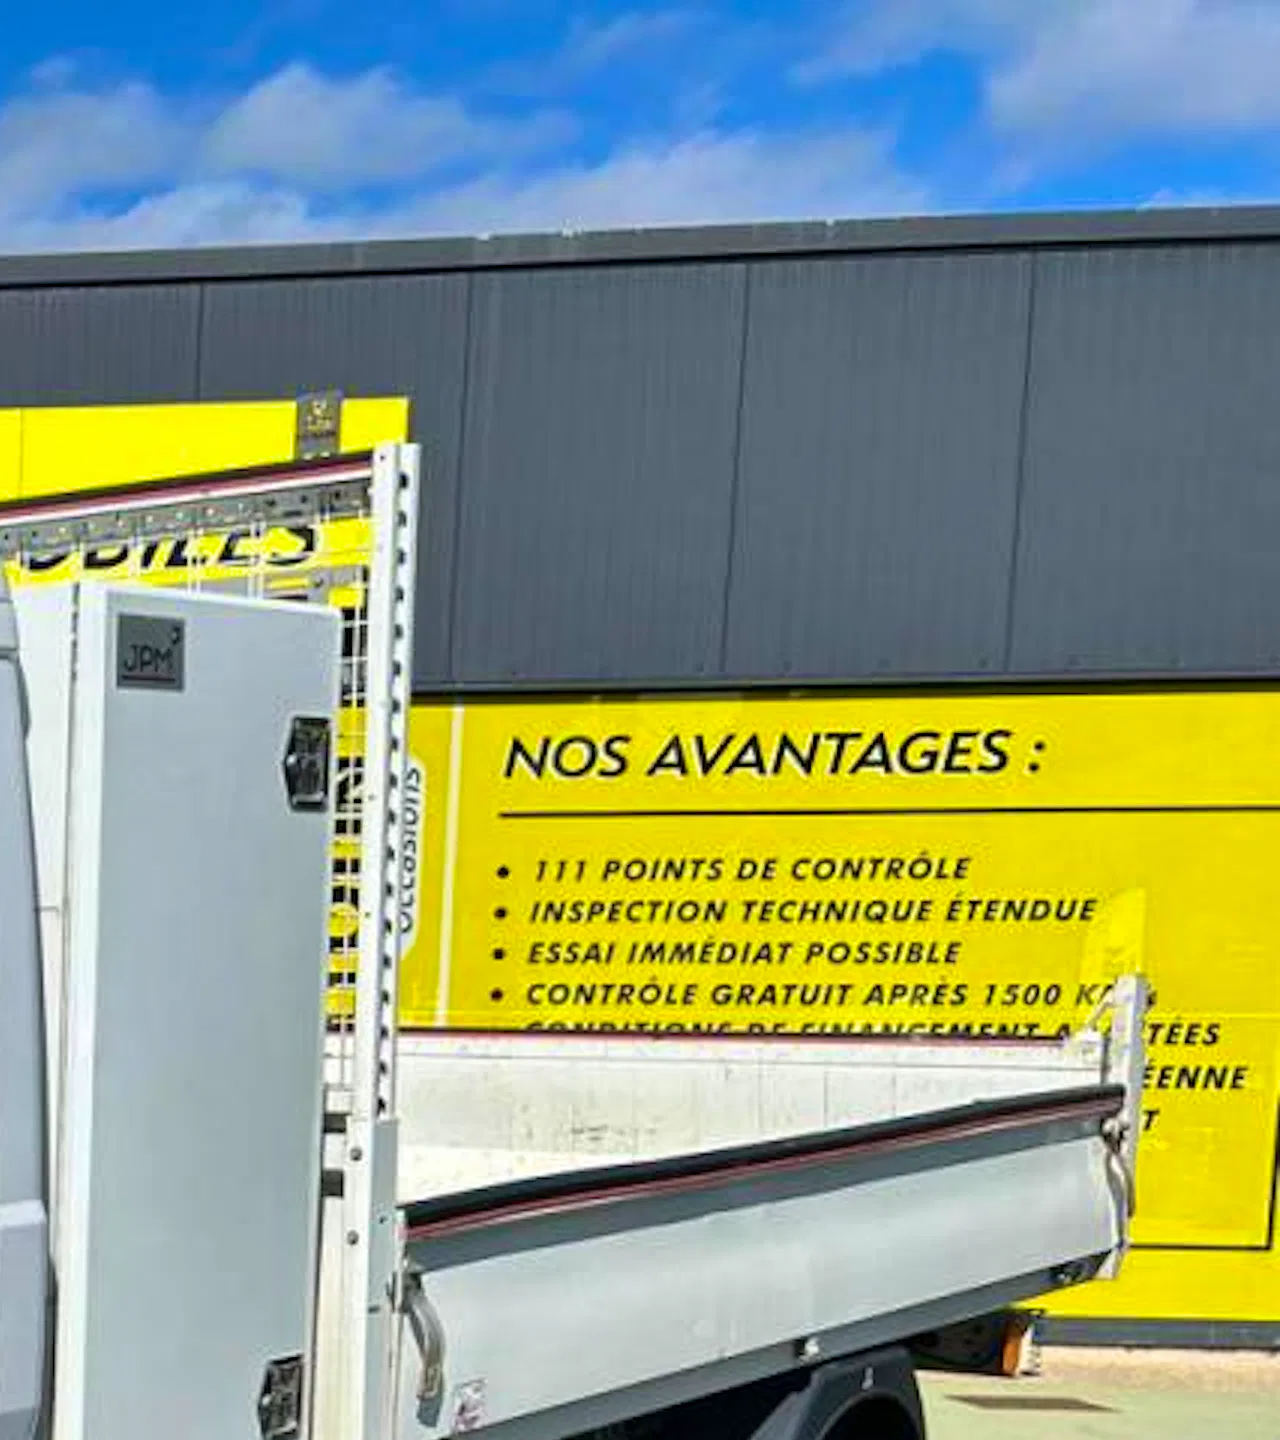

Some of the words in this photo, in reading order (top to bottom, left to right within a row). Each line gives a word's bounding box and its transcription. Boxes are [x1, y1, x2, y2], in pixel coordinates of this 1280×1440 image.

[123, 643, 174, 673] JPM
[503, 735, 631, 779] NOS
[646, 730, 1013, 777] AVANTAGES
[536, 860, 587, 882] 111
[602, 858, 724, 882] POINTS
[737, 858, 778, 881] DE
[791, 850, 972, 881] CONTRÔLE
[529, 900, 728, 923] INSPECTION
[742, 899, 933, 923] TECHNIQUE
[945, 891, 1098, 922] ÉTENDUE
[527, 942, 617, 965] ESSAI
[627, 936, 794, 965] IMMÉDIAT
[804, 942, 962, 965] POSSIBLE
[526, 975, 698, 1006] CONTRÔLE
[711, 984, 855, 1006] GRATUIT
[862, 975, 969, 1006] APRÈS
[984, 983, 1062, 1006] 1500
